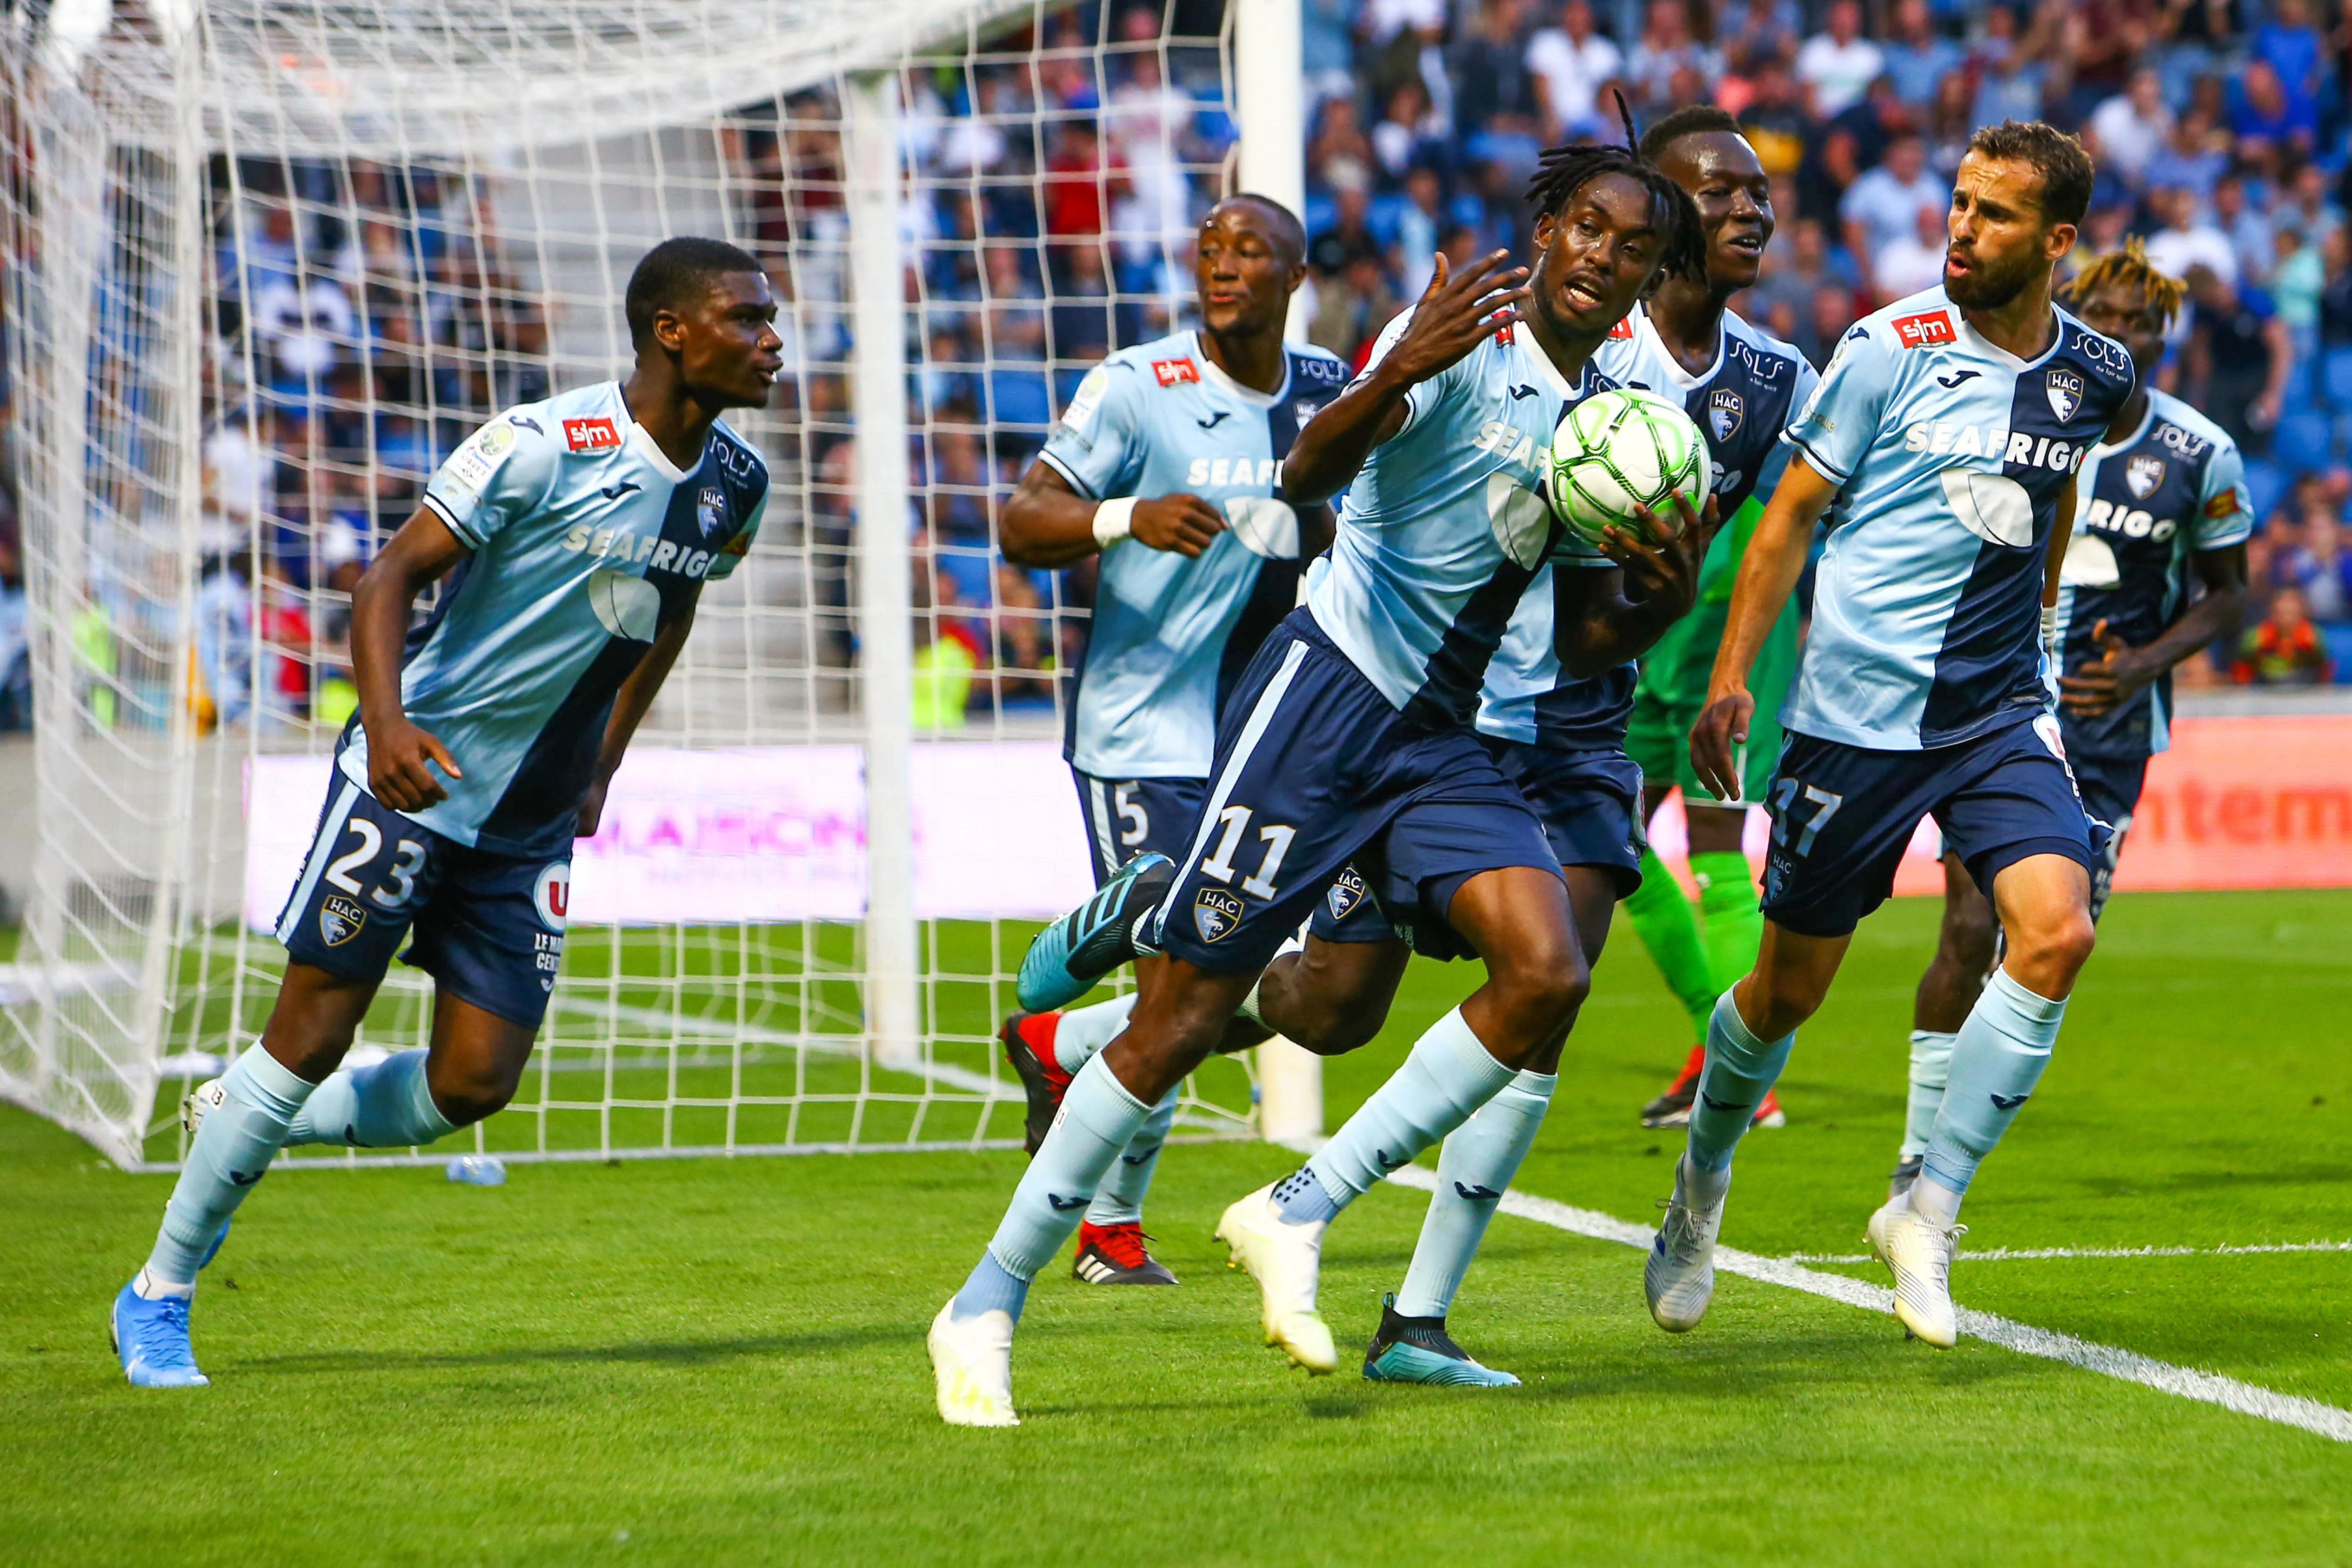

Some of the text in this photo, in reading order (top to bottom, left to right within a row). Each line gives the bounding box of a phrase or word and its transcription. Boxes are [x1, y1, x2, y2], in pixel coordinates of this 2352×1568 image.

[1730, 341, 1784, 379] SOL'S
[2071, 333, 2127, 370] SOL'S
[2052, 374, 2079, 391] HAC
[1715, 394, 1739, 410] HAC
[1471, 421, 1549, 476] SEAF
[1905, 421, 2084, 475] SEAFRIGO
[703, 490, 723, 507] HAC
[2087, 498, 2177, 543] RIGO
[1114, 780, 1149, 846] 5
[325, 817, 427, 907] 23
[1200, 805, 1297, 901] 11
[1773, 854, 1791, 874] HAC
[330, 899, 361, 921] HAC
[549, 881, 569, 916] U
[1204, 892, 1237, 913] HAC
